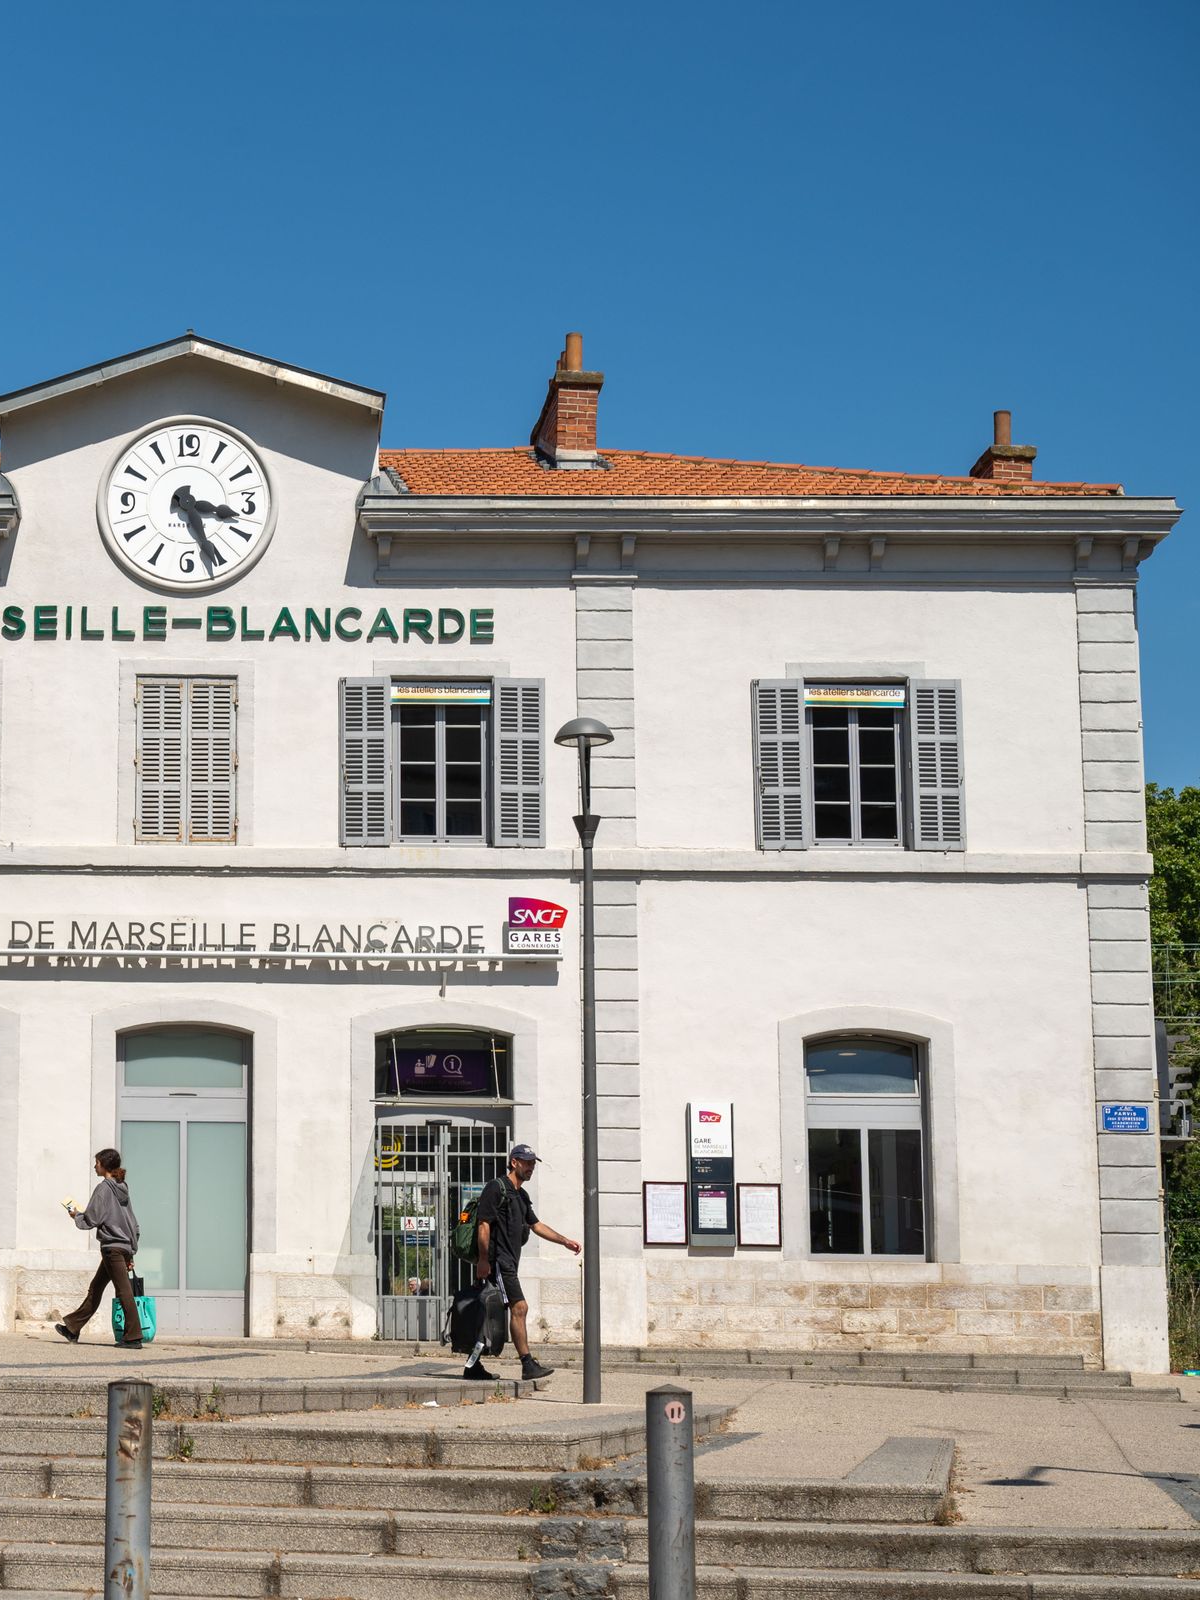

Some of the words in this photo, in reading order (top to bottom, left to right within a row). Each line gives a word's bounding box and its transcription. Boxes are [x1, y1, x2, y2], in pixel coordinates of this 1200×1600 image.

[177, 434, 200, 457] 12
[120, 492, 136, 514] 9
[241, 492, 256, 515] 3
[179, 551, 195, 573] 6
[397, 686, 410, 694] les
[411, 686, 443, 694] ateliers
[444, 686, 488, 694] blancarde
[808, 688, 822, 696] les
[823, 688, 855, 696] ateliers
[856, 688, 901, 697] blancarde
[511, 909, 564, 924] SNCF
[11, 920, 55, 947] DE
[71, 921, 256, 948] MARSEILLE
[273, 923, 484, 951] BLANCARDE
[510, 933, 561, 943] GARES
